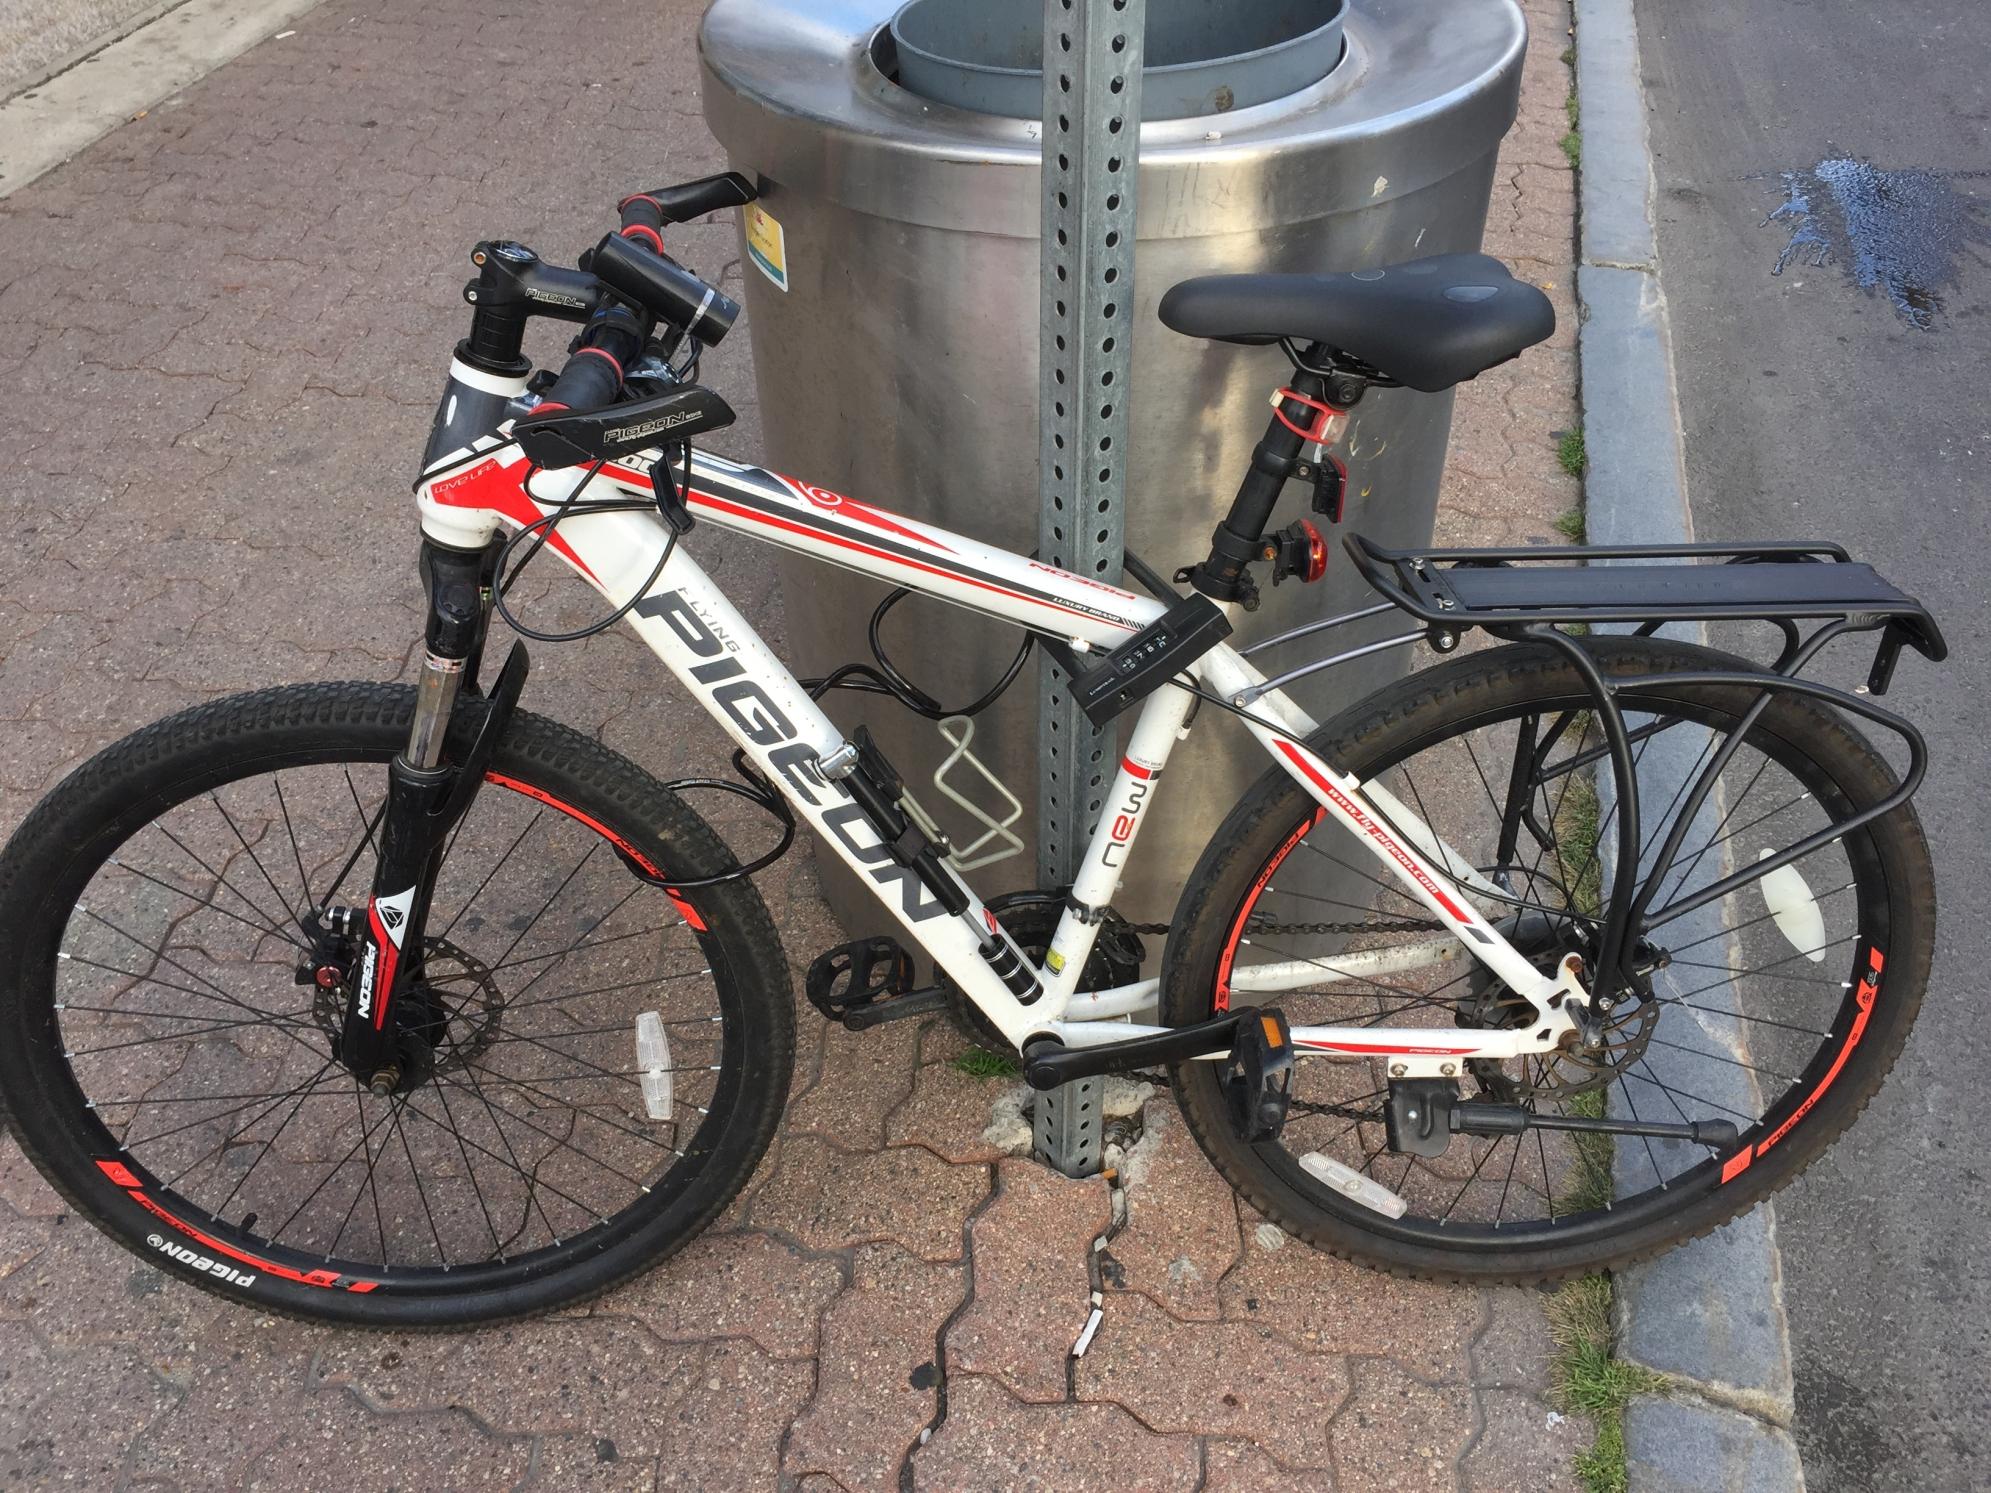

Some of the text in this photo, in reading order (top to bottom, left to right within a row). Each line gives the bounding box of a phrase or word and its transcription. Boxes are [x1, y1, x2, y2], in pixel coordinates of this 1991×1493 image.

[603, 411, 686, 443] PIGEON
[677, 587, 740, 654] FLYING
[1053, 597, 1120, 621] LUXURY BRAND
[633, 590, 947, 923] PIGEON
[1328, 788, 1438, 894] www.fly-pigeon.com
[357, 940, 377, 1019] PIGEON
[159, 1241, 257, 1288] PIGEON
